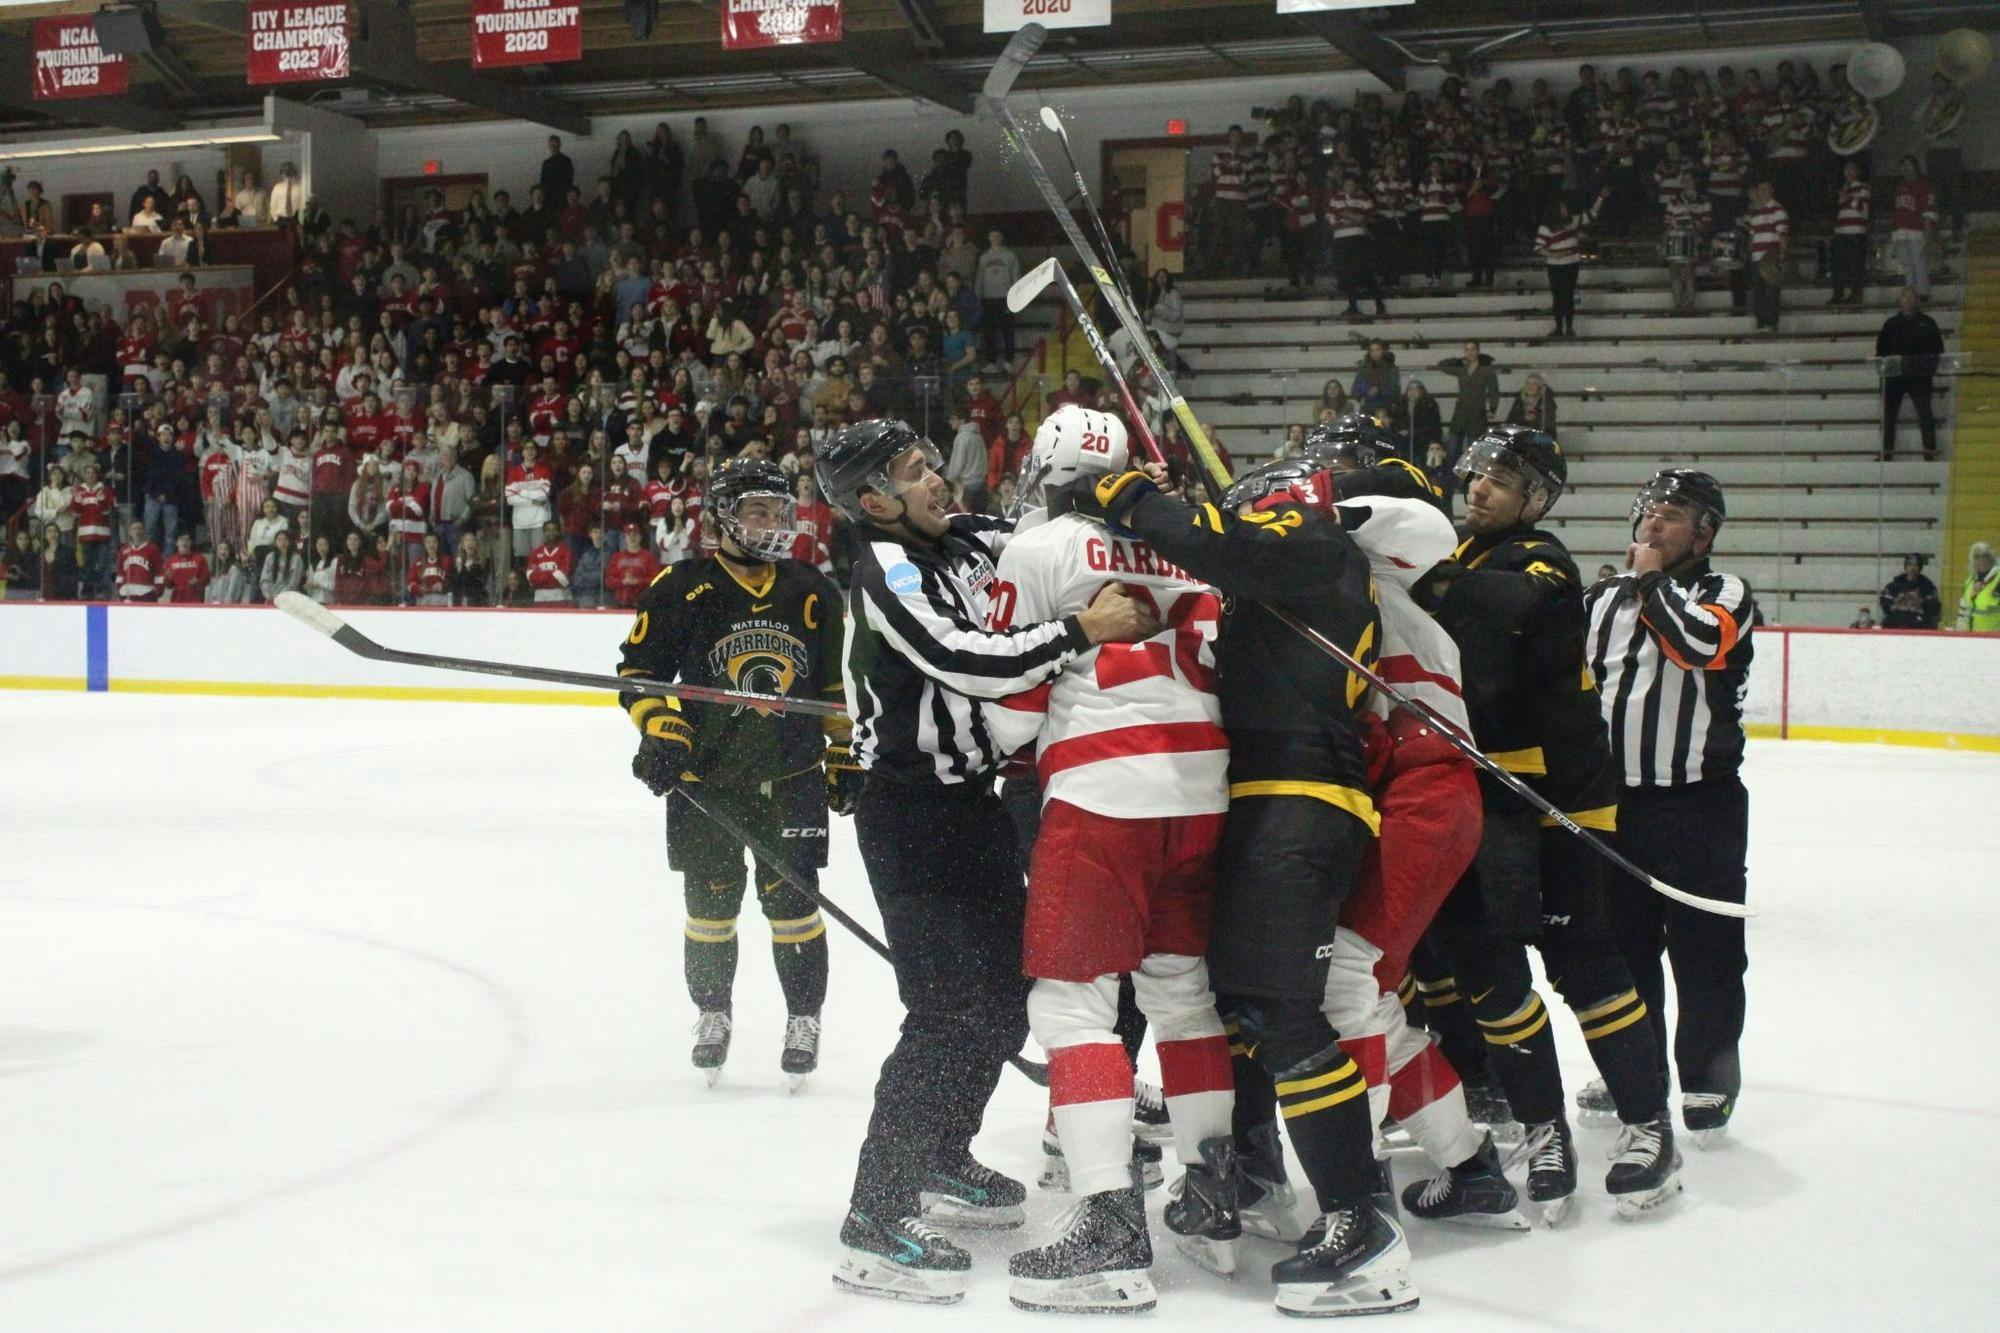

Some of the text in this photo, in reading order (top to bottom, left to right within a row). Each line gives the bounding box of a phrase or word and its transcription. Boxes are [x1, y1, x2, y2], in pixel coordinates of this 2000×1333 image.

[252, 4, 347, 31] IVY LEAGUE
[1023, 0, 1071, 15] 2020
[475, 6, 579, 34] TOURNAMENT
[253, 25, 346, 52] CHAMPIONS
[505, 29, 549, 53] 2020
[36, 47, 123, 69] TOURNAM
[279, 48, 320, 73] 2023
[62, 66, 99, 87] 2023
[1080, 432, 1110, 454] 20
[685, 582, 714, 601] OUA
[892, 573, 922, 591] NCAA
[803, 593, 818, 630] C
[730, 619, 790, 633] WATERLOO
[708, 632, 810, 679] WARRIORS
[1551, 810, 1579, 832] CCM
[780, 827, 828, 838] CCM
[1315, 943, 1334, 960] CC
